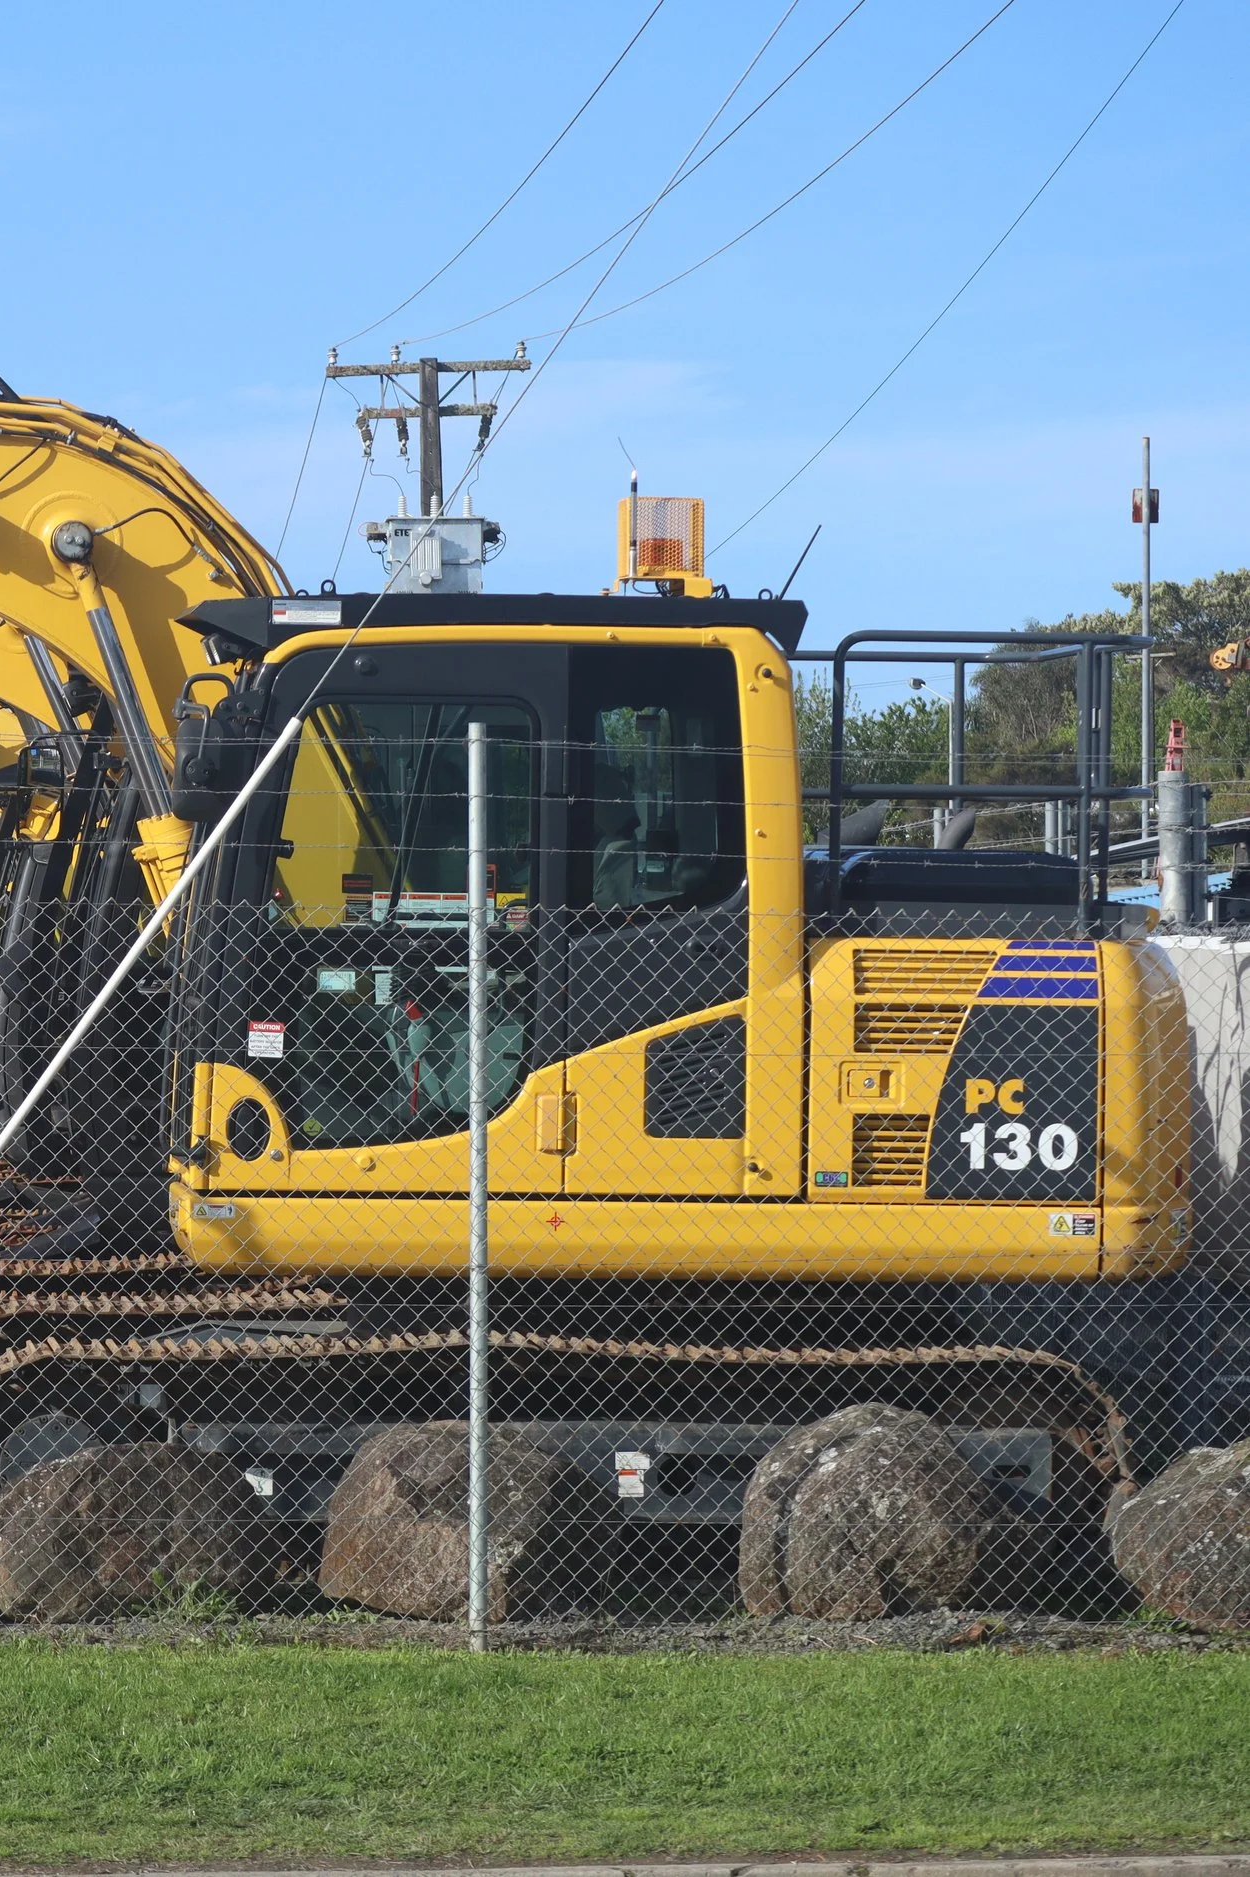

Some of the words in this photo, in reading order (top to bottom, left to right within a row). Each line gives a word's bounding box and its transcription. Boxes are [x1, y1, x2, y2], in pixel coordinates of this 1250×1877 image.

[253, 1023, 281, 1031] CAUTION
[965, 1078, 1024, 1115] PC
[960, 1122, 1079, 1171] 130
